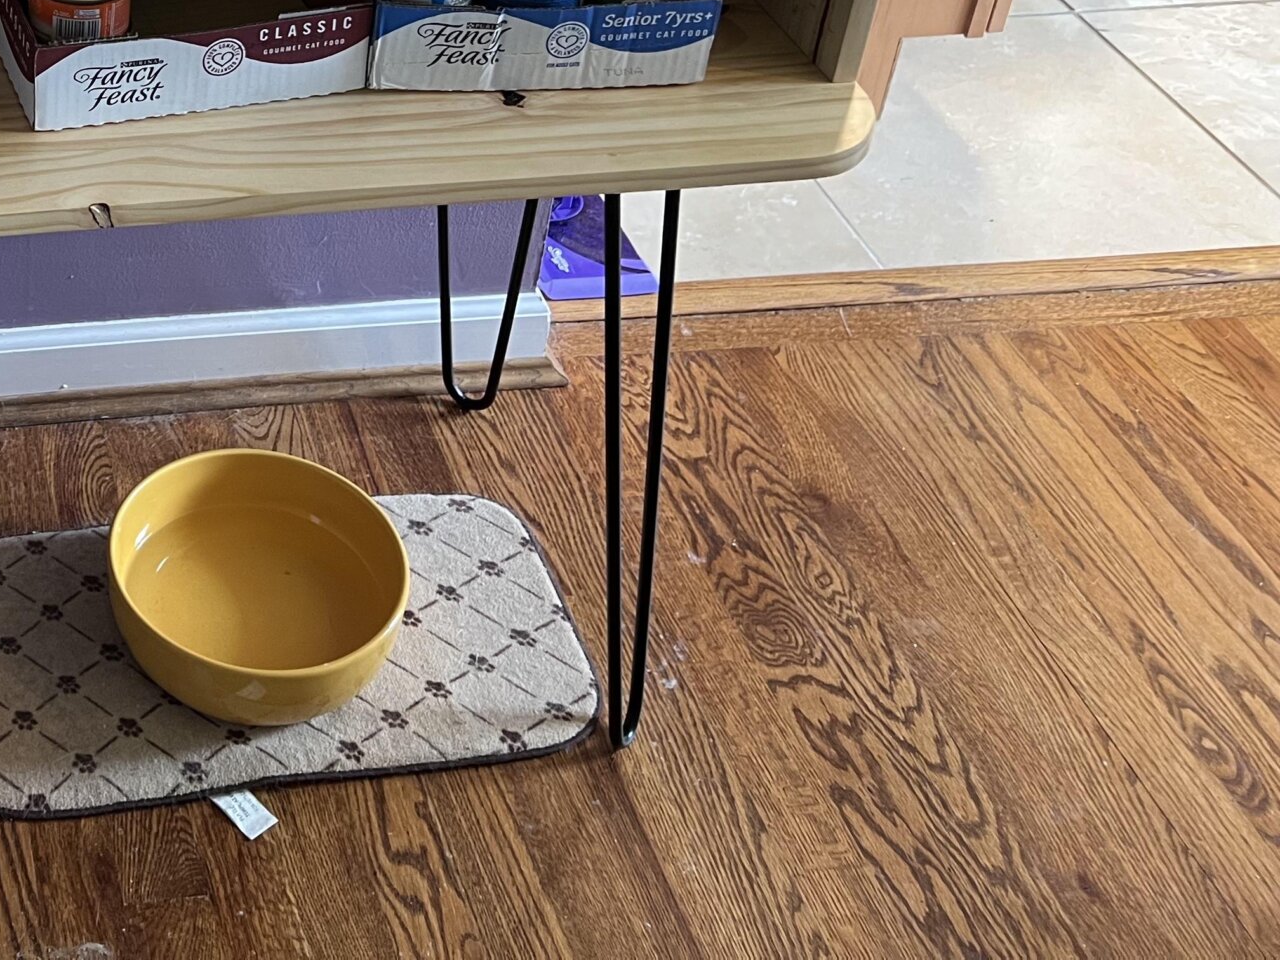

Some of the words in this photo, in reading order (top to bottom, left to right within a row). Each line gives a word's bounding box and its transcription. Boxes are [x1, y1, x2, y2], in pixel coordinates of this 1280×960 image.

[259, 16, 352, 42] CLASSIC
[602, 12, 661, 28] Senior
[664, 11, 713, 28] 7yrs+
[263, 44, 302, 55] GOURMET
[305, 41, 320, 49] CAT
[324, 38, 345, 47] FOOD
[417, 22, 512, 50] Fancy
[600, 31, 651, 42] GOURMET
[656, 30, 676, 39] CAT
[680, 29, 709, 38] FOOD
[426, 44, 505, 67] Feast
[74, 63, 168, 91] Fancy
[88, 82, 164, 111] Feast
